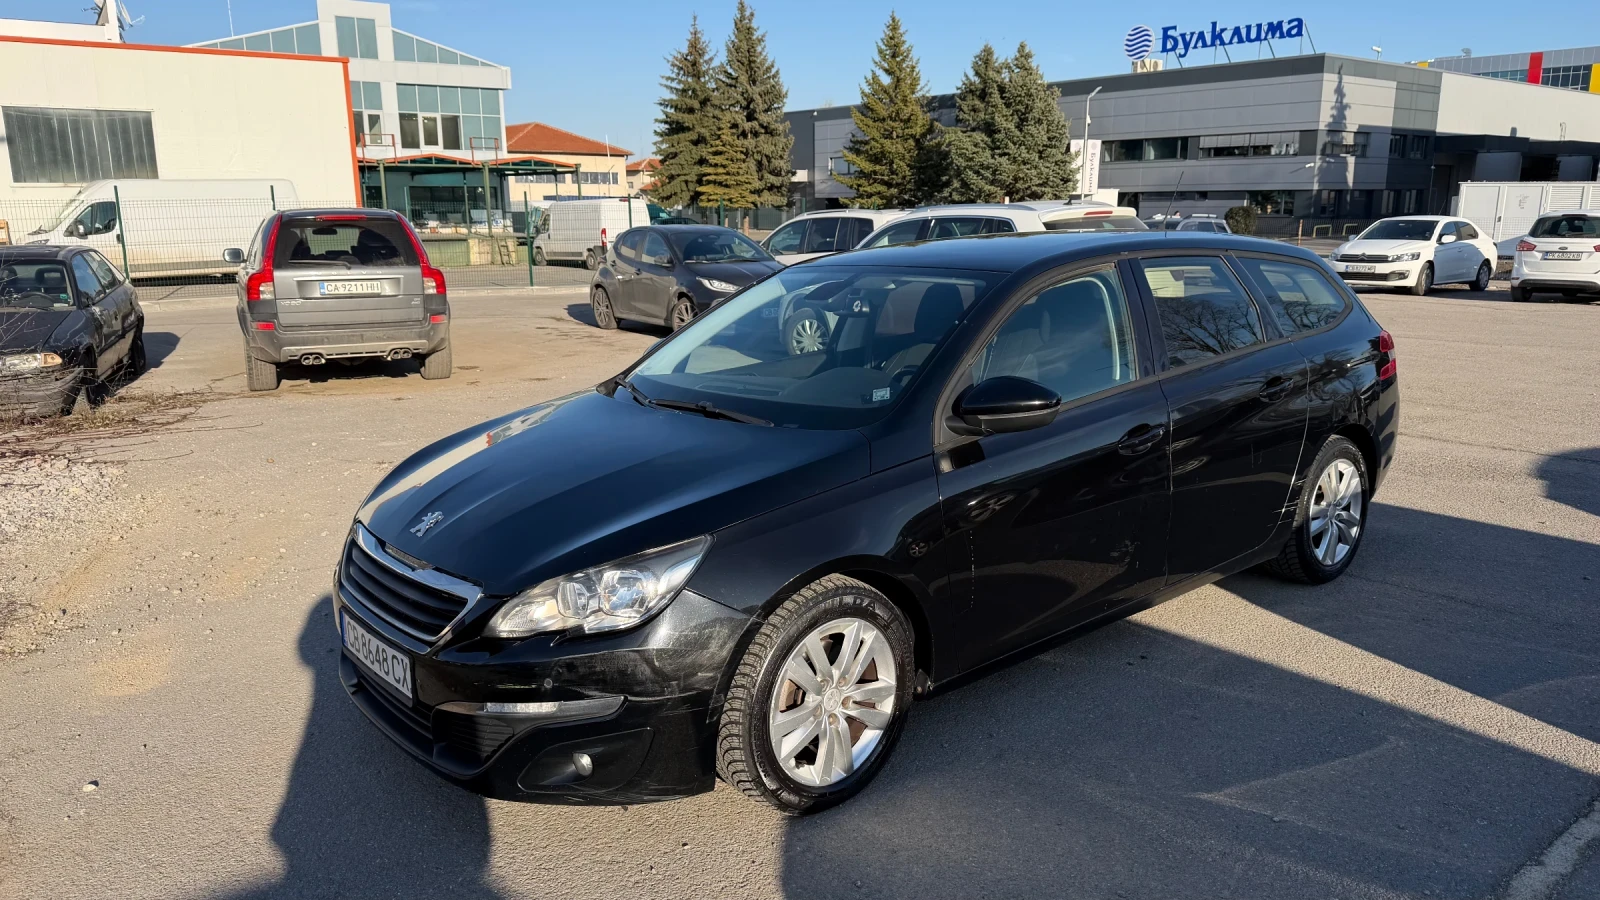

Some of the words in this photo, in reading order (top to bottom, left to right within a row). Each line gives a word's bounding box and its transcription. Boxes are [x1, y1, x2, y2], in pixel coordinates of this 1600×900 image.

[1160, 17, 1304, 58] Булклима
[326, 283, 340, 292] CA
[341, 283, 364, 292] 9211
[346, 620, 360, 654] CB
[361, 632, 390, 677] 8648
[391, 654, 410, 692] CX
